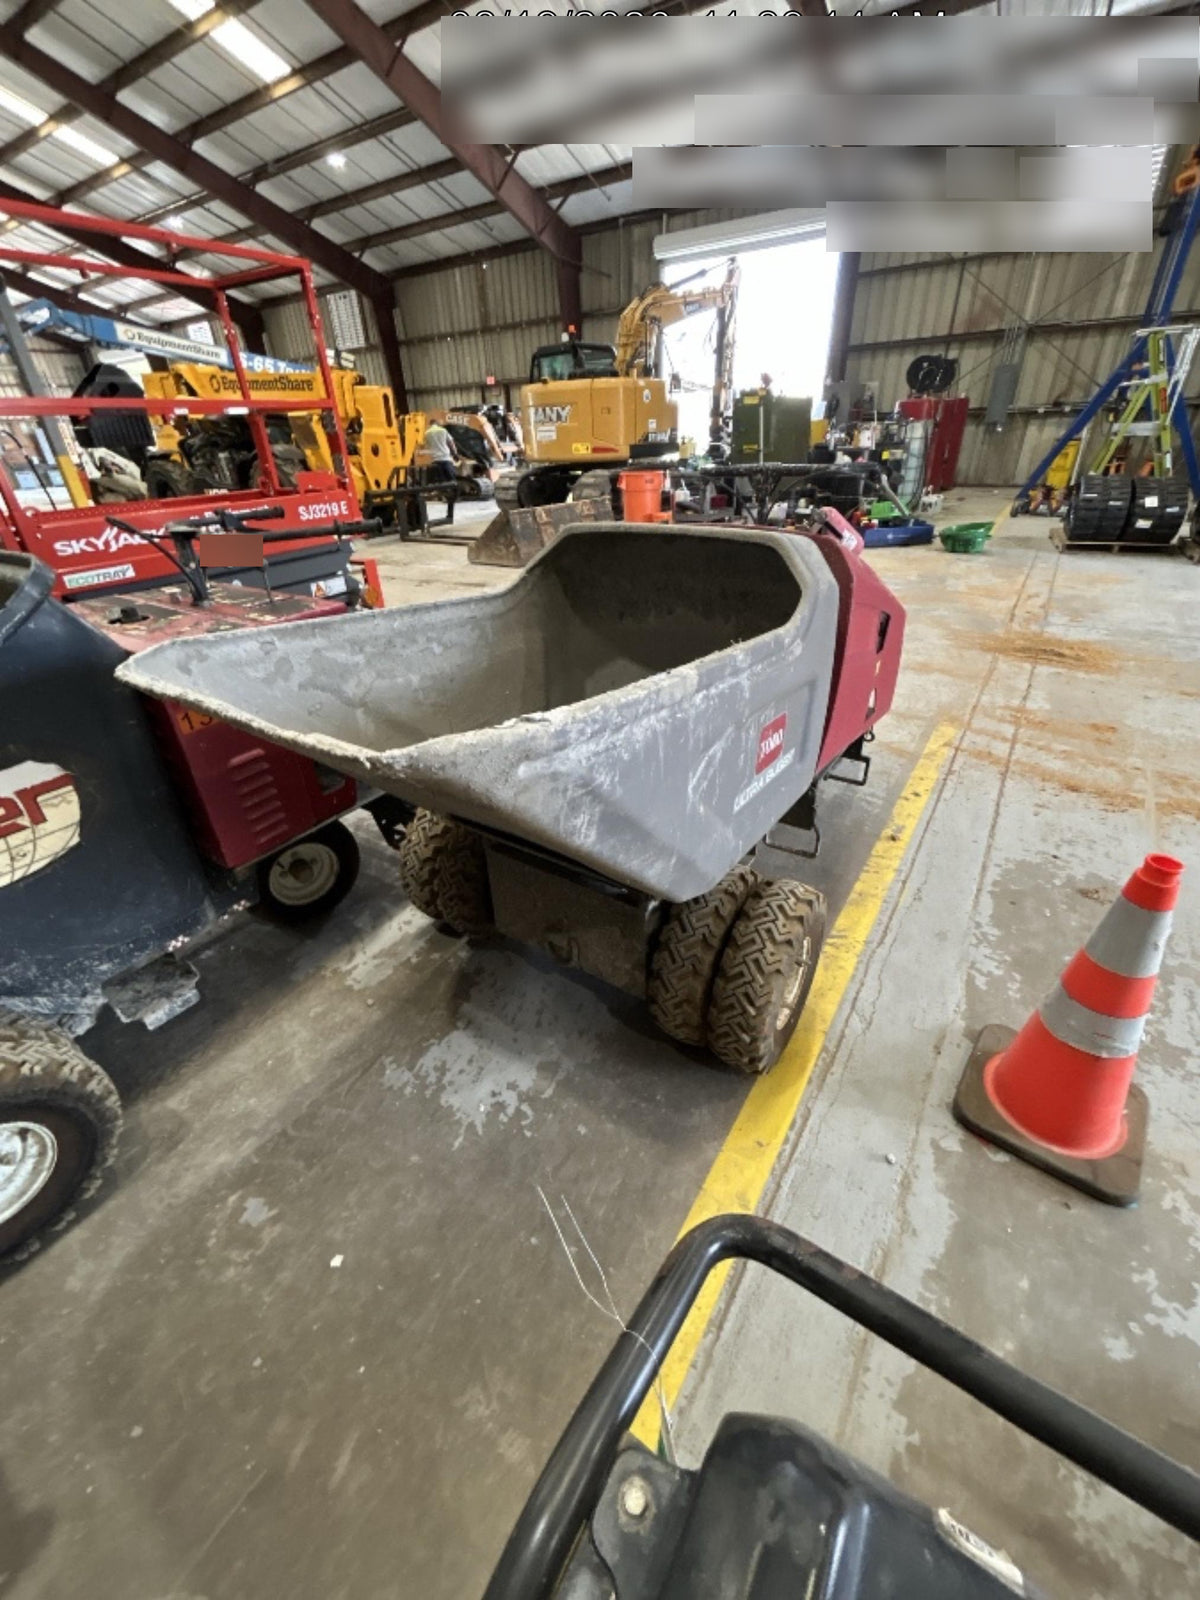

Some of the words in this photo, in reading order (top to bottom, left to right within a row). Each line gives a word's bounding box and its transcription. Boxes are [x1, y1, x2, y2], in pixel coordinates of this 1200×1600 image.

[221, 376, 314, 394] EqumentShare
[529, 405, 571, 422] ANY
[298, 503, 338, 521] SJ3219
[340, 501, 349, 515] E
